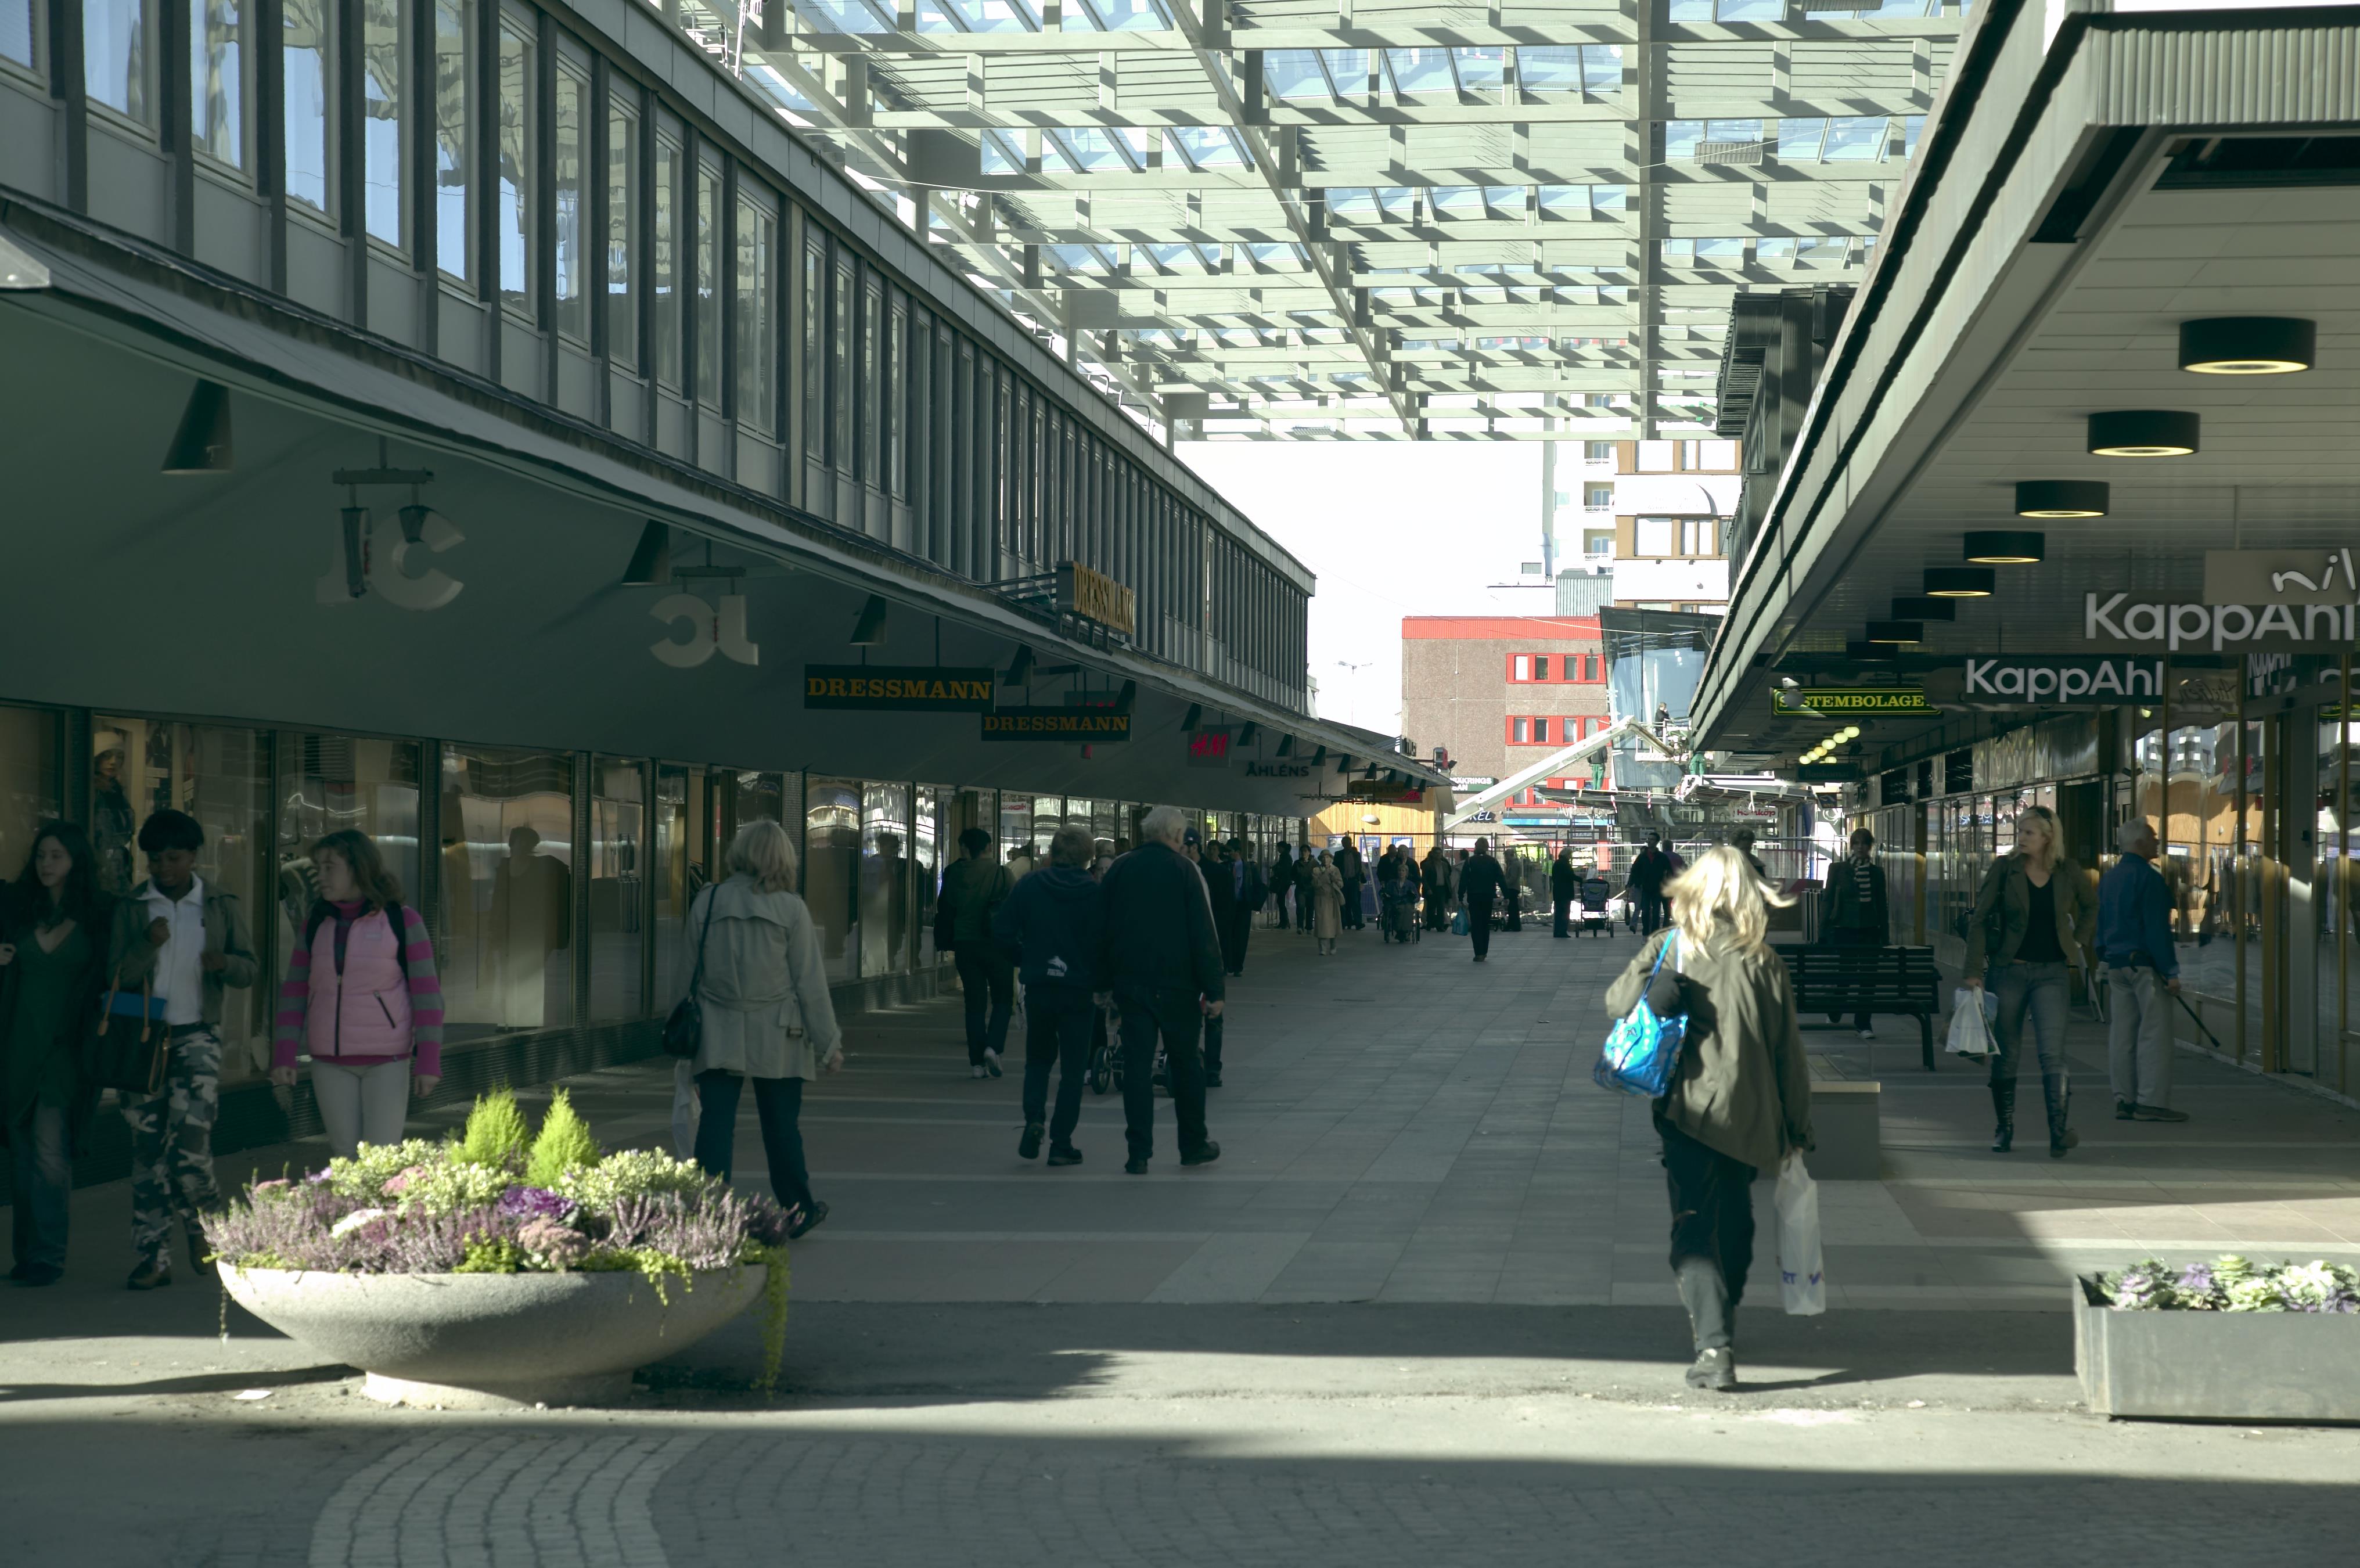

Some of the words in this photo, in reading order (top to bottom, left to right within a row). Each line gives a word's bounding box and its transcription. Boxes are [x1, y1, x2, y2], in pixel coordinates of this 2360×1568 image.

[2271, 548, 2360, 604] nil
[1073, 560, 1135, 635] DRESSMANN
[2085, 593, 2355, 651] KappAhl
[807, 677, 992, 700] DRESSMANN
[1966, 659, 2164, 703] KappAhl
[1779, 696, 1930, 707] SSTEMBOLAGE
[984, 715, 1129, 732] DRESSMANN
[1246, 761, 1309, 777] ÅHLÉNS
[1450, 776, 1492, 785] SÄKRINGS
